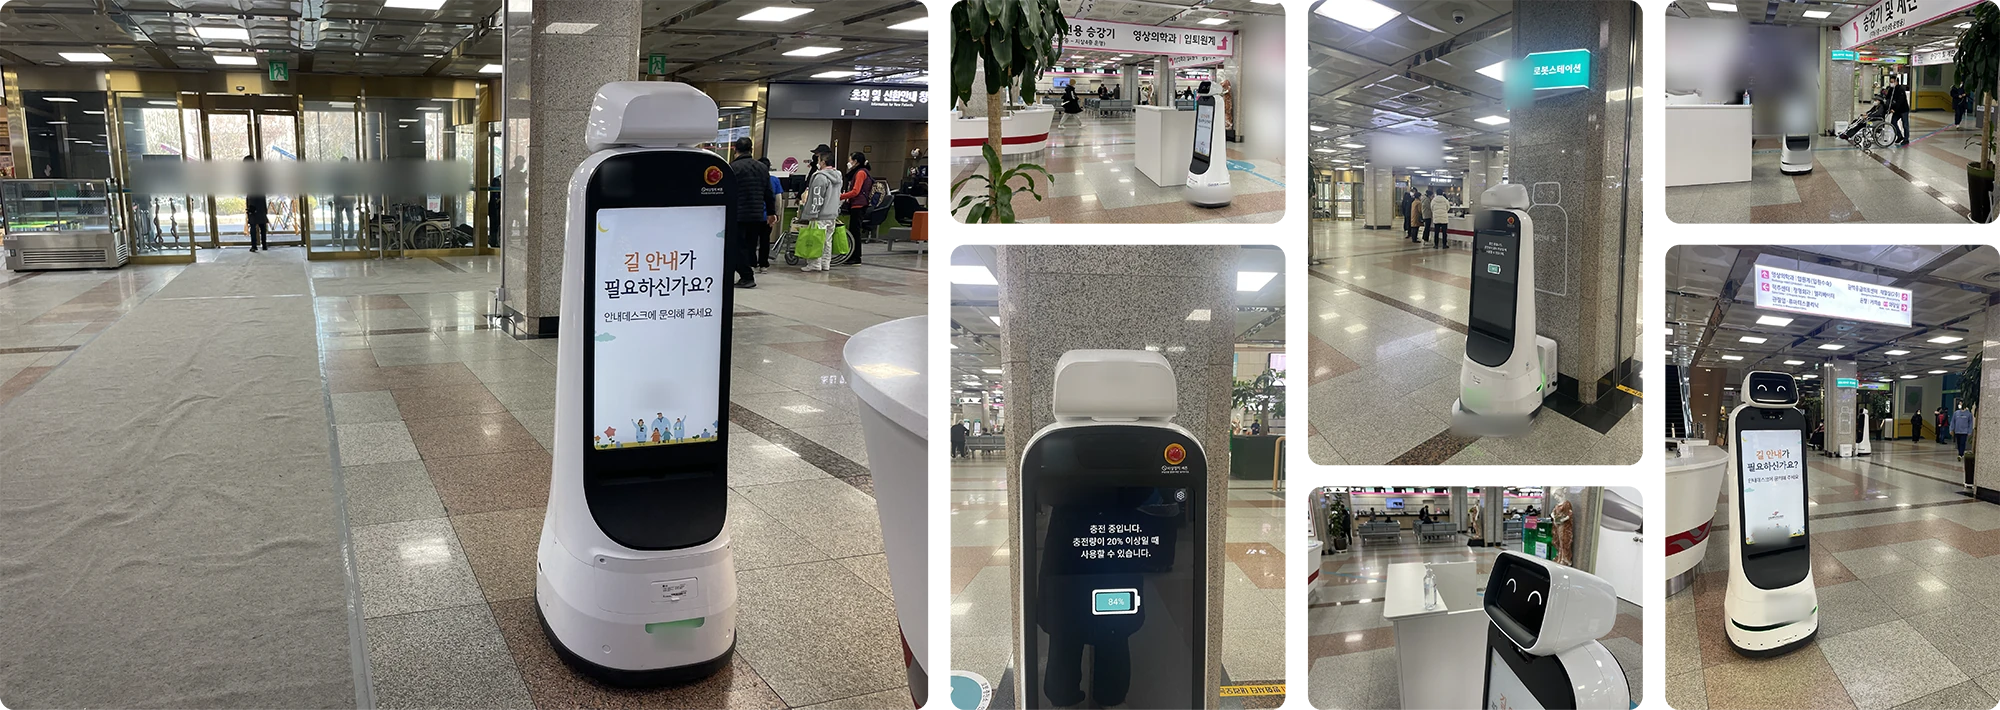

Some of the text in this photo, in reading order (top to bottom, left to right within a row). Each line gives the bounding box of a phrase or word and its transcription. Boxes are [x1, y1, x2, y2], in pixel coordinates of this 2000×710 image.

[1863, 4, 1882, 32] 승강기
[1885, 0, 1894, 21] 및
[1086, 26, 1115, 39] 승강기
[1133, 30, 1177, 43] 영상의학과
[1184, 34, 1216, 46] 입퇴원계
[1533, 63, 1581, 76] 로봇스테이션
[850, 89, 870, 101] 초진
[871, 90, 881, 102] 및
[883, 90, 918, 103] 신환안내
[624, 250, 697, 272] 길 안내가
[604, 276, 714, 299] 필요하신가요?
[604, 307, 713, 323] 안내데스크에 문의해 주세요
[1756, 450, 1764, 460] 길
[1747, 460, 1799, 472] 필요하신가요?
[1090, 524, 1143, 534] 충전 중입니다.
[1072, 535, 1160, 547] 충전량이 20% 이상일 때
[1080, 548, 1152, 559] 사용할 수 있습니다.
[1107, 598, 1125, 606] 84%
